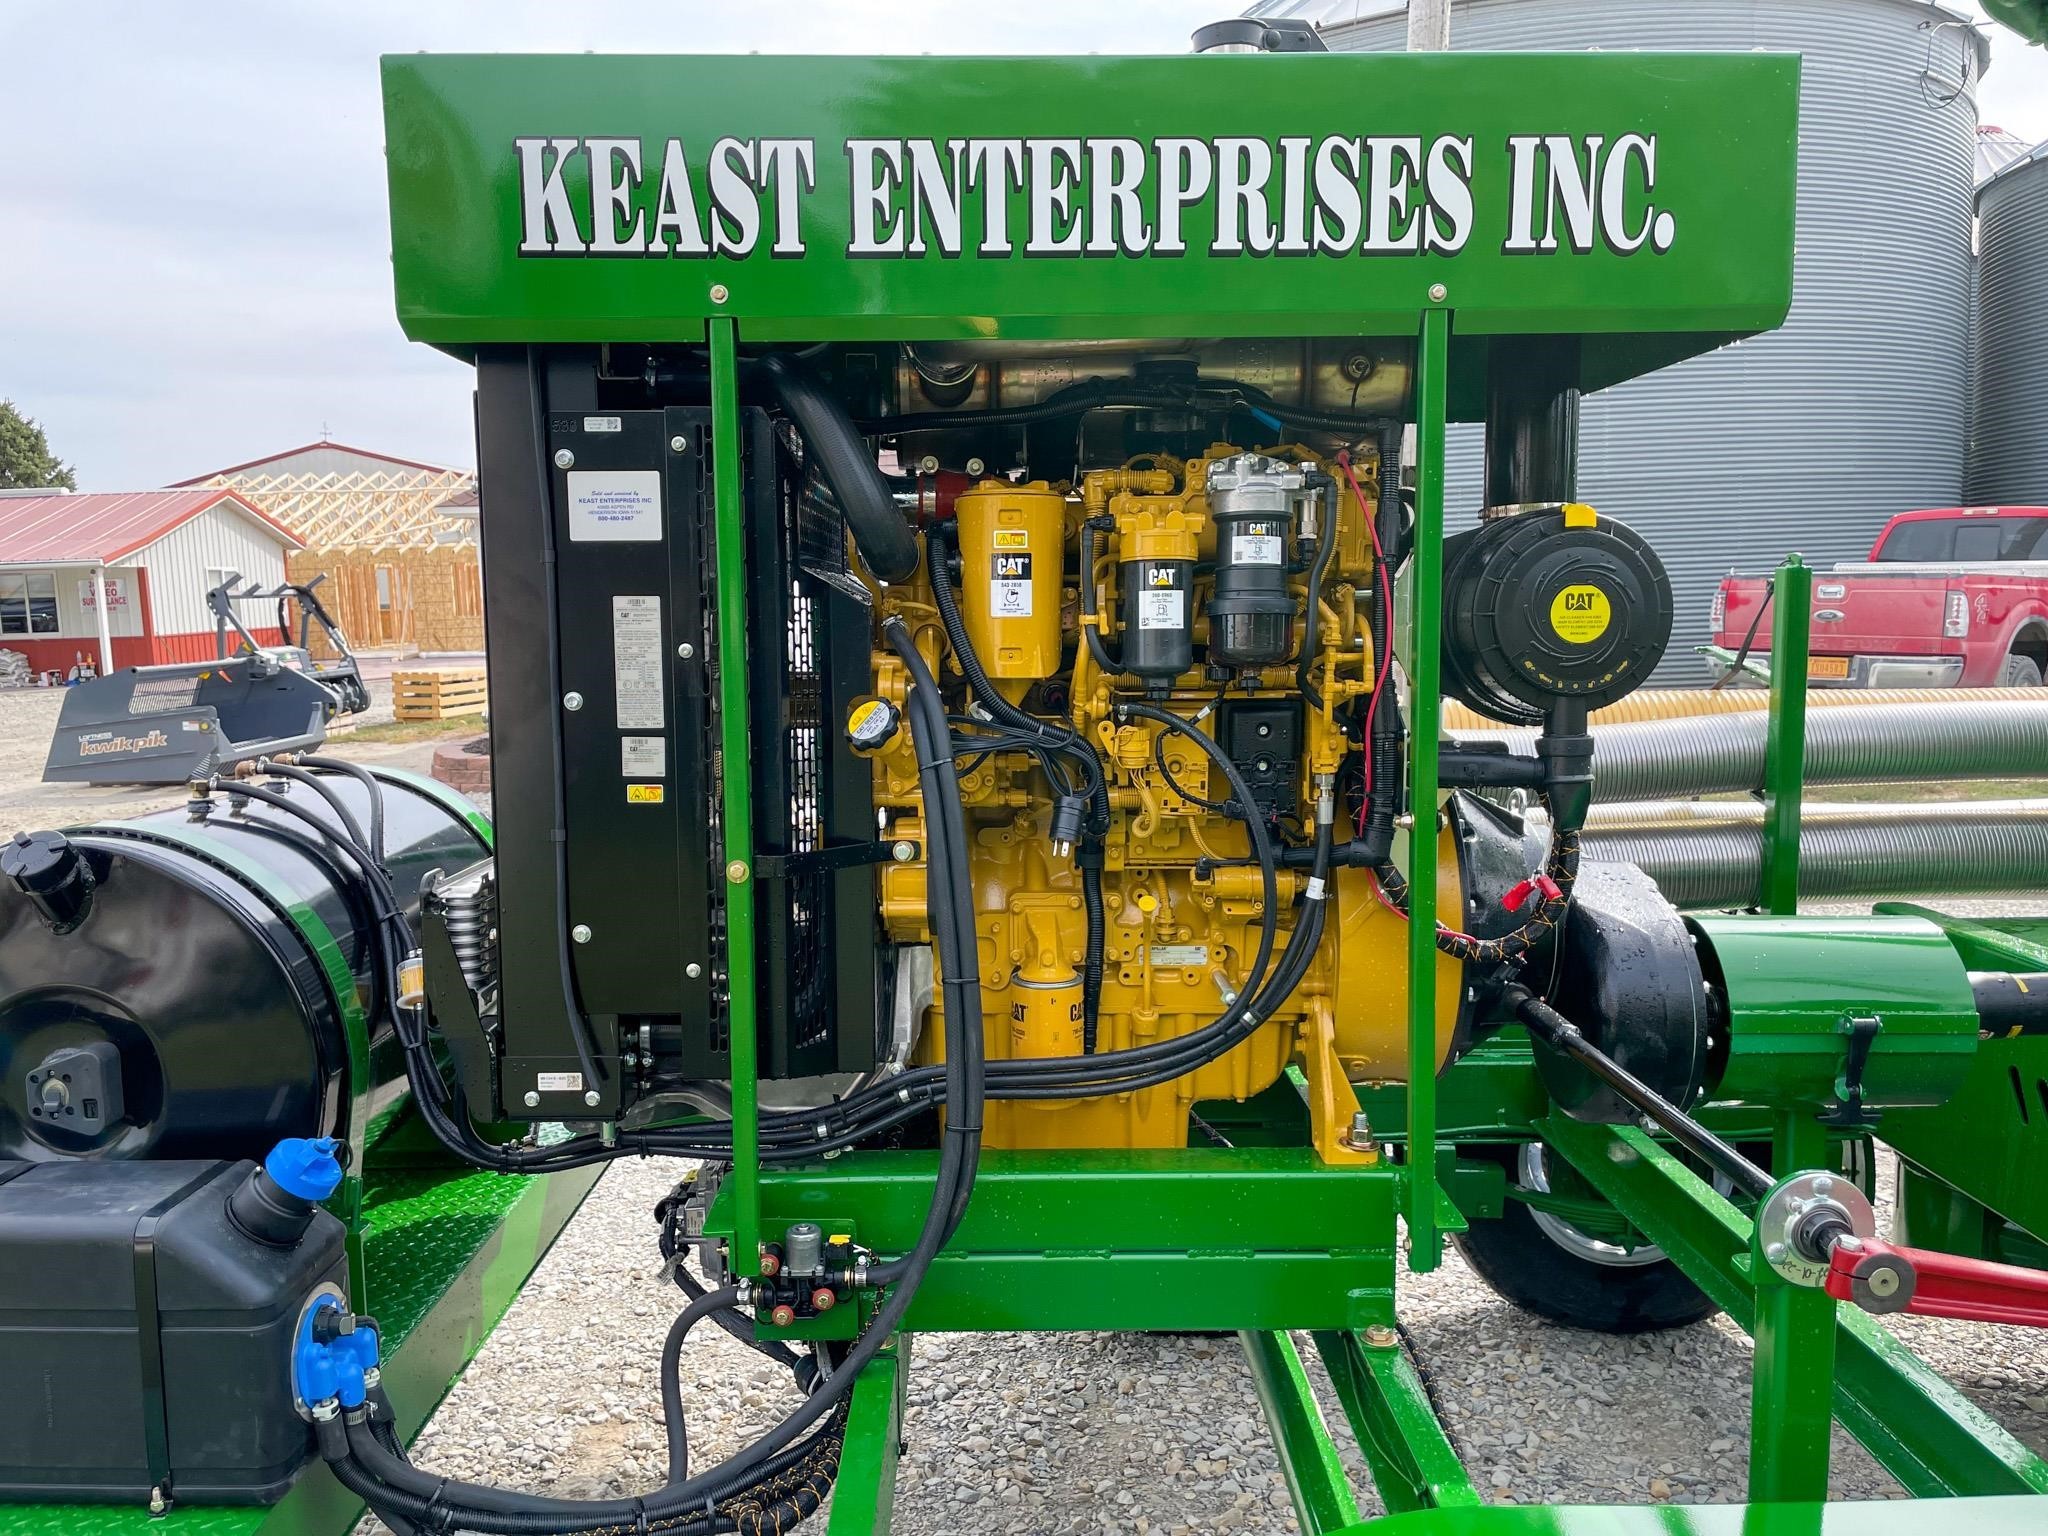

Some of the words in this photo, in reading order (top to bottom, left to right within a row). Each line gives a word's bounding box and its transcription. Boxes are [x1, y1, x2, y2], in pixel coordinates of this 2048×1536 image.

[515, 136, 816, 261] KEAST
[843, 133, 1474, 260] ENTERPRISES
[1500, 132, 1676, 257] INC.
[1249, 523, 1267, 535] CAT
[1148, 568, 1176, 586] CAT
[89, 588, 117, 597] VEO
[1565, 592, 1595, 611] CAT
[78, 731, 113, 743] LOFTNESS
[79, 736, 133, 756] kwik
[132, 733, 168, 753] pik
[1011, 1000, 1026, 1023] AT
[1069, 1001, 1083, 1023] CA
